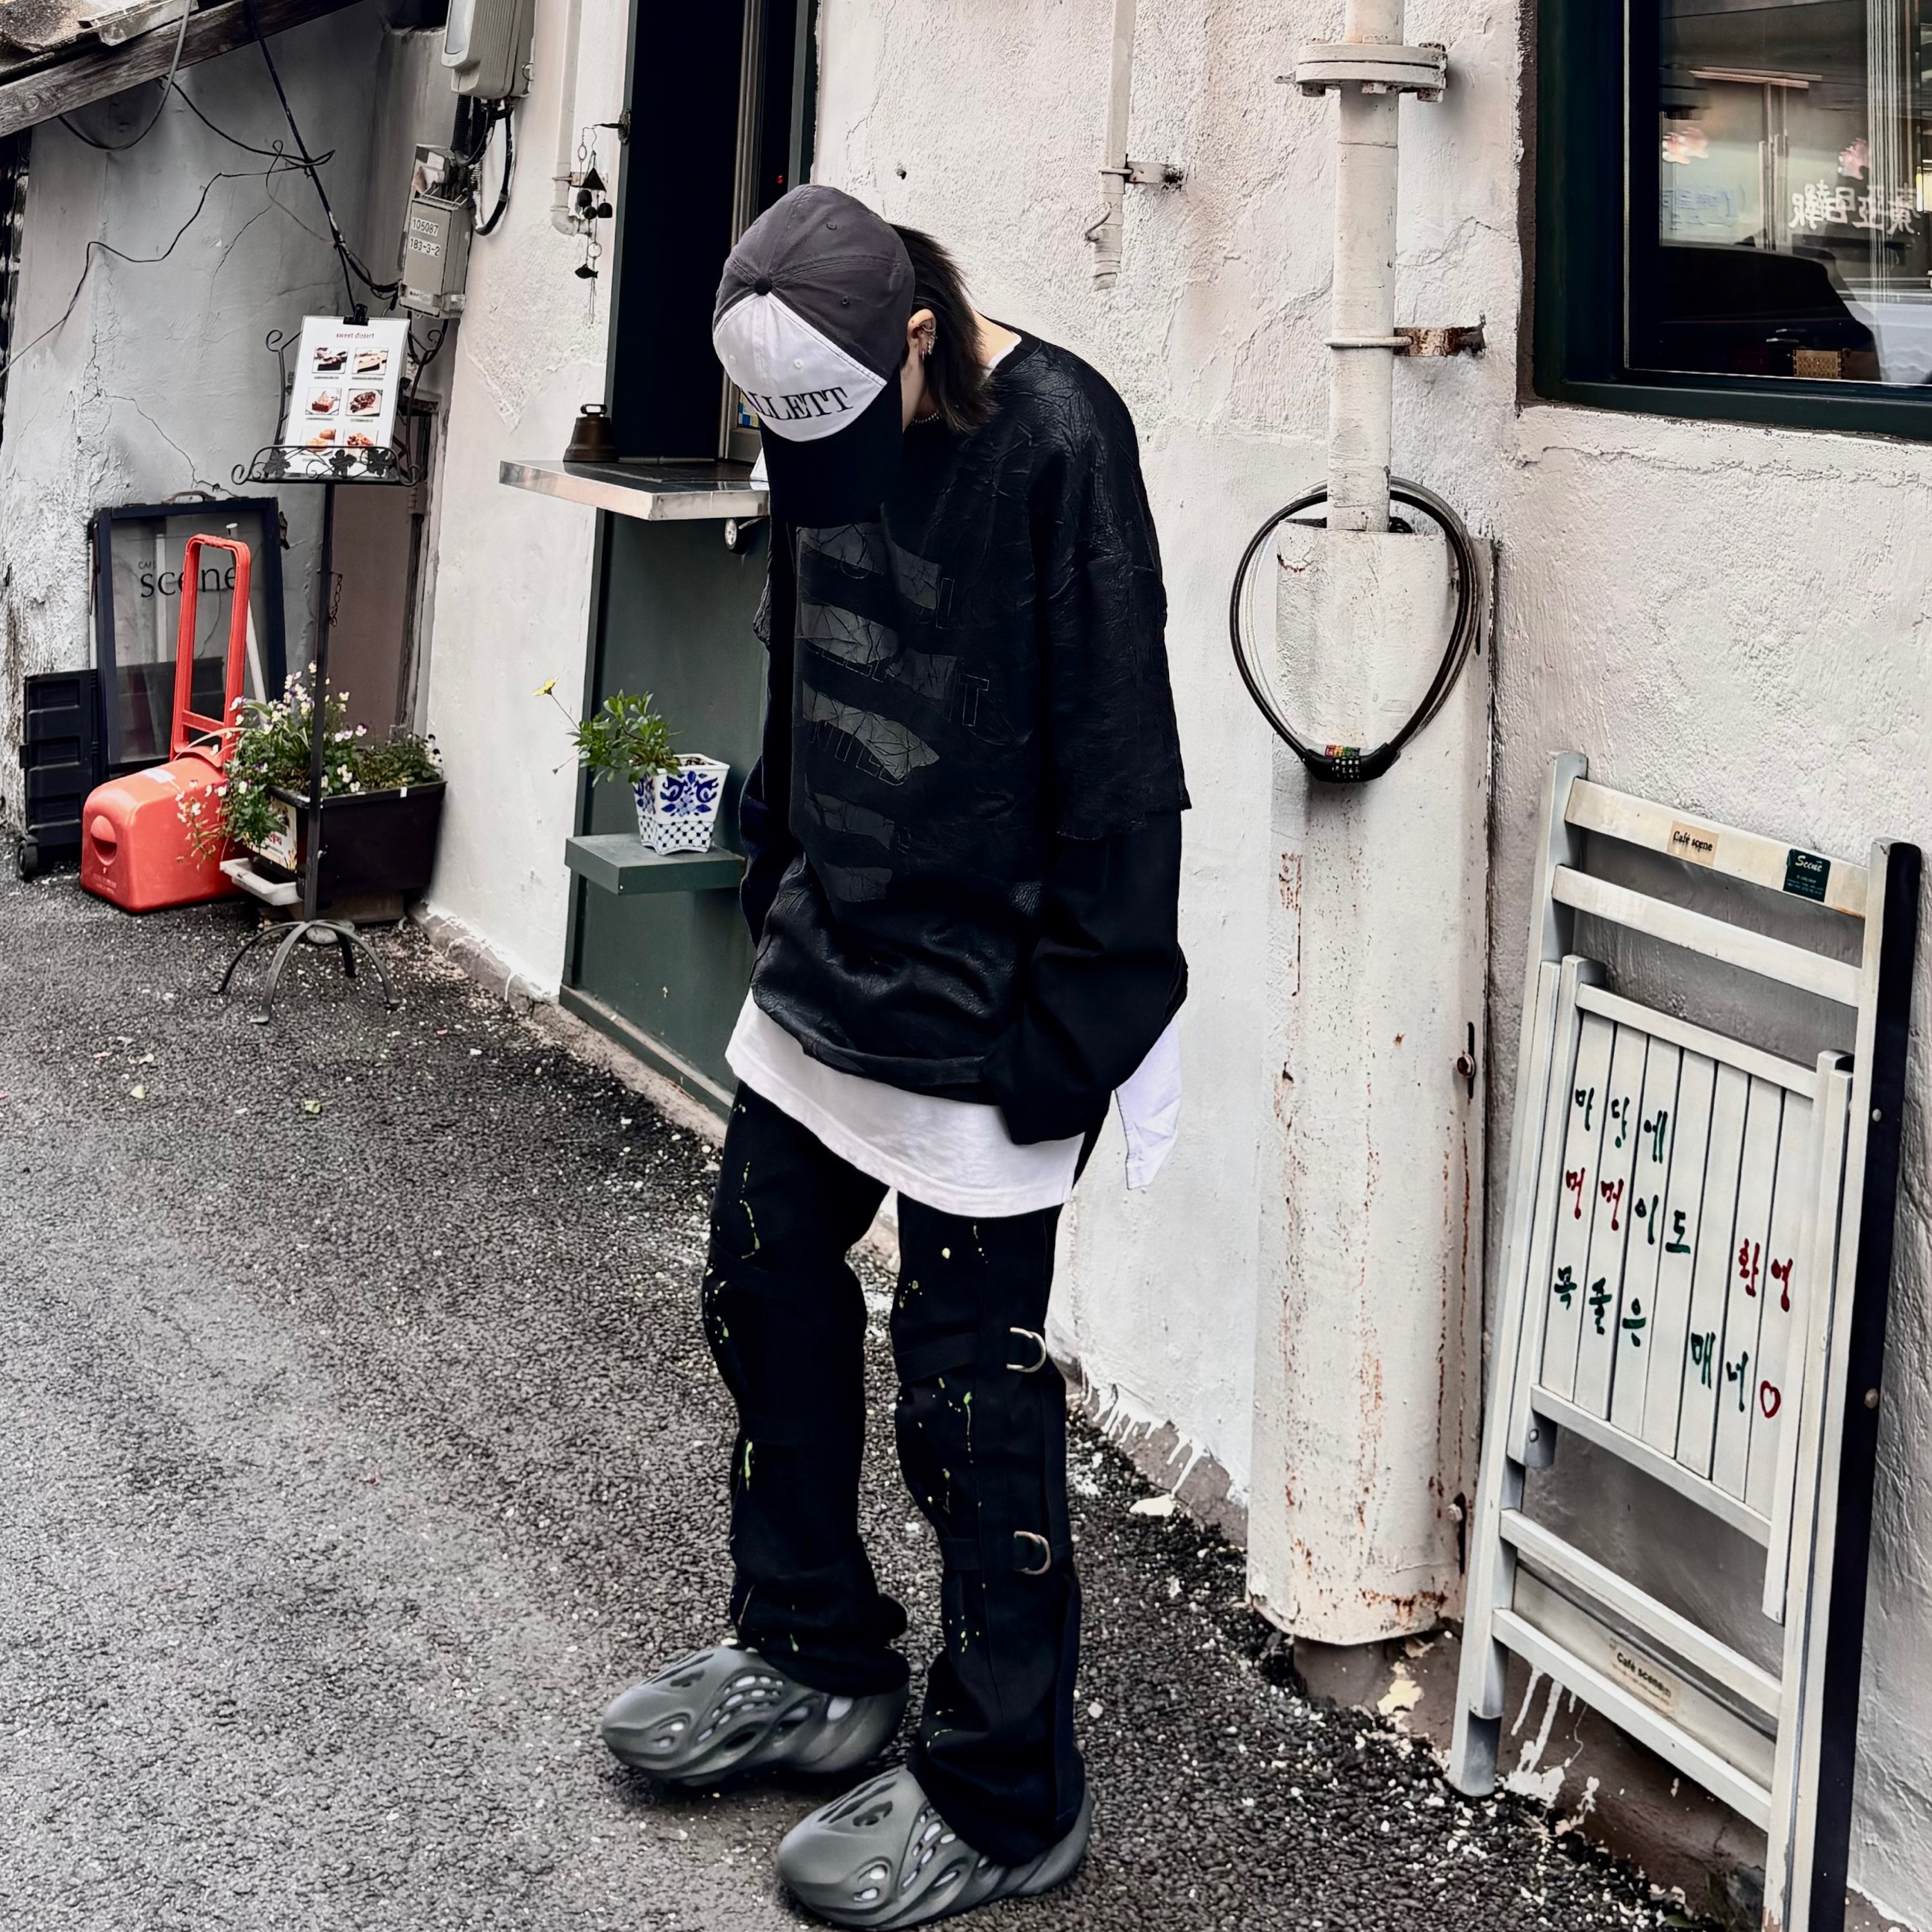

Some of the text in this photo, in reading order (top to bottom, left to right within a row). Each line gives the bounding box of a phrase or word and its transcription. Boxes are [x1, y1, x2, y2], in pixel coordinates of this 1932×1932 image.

[410, 237, 440, 256] 183-3-2
[140, 567, 235, 598] scne
[1795, 856, 1822, 872] Scene
[1575, 1087, 1668, 1164] 마당에
[1739, 1238, 1793, 1312] 환영
[1554, 1265, 1748, 1412] 목줄은 매너
